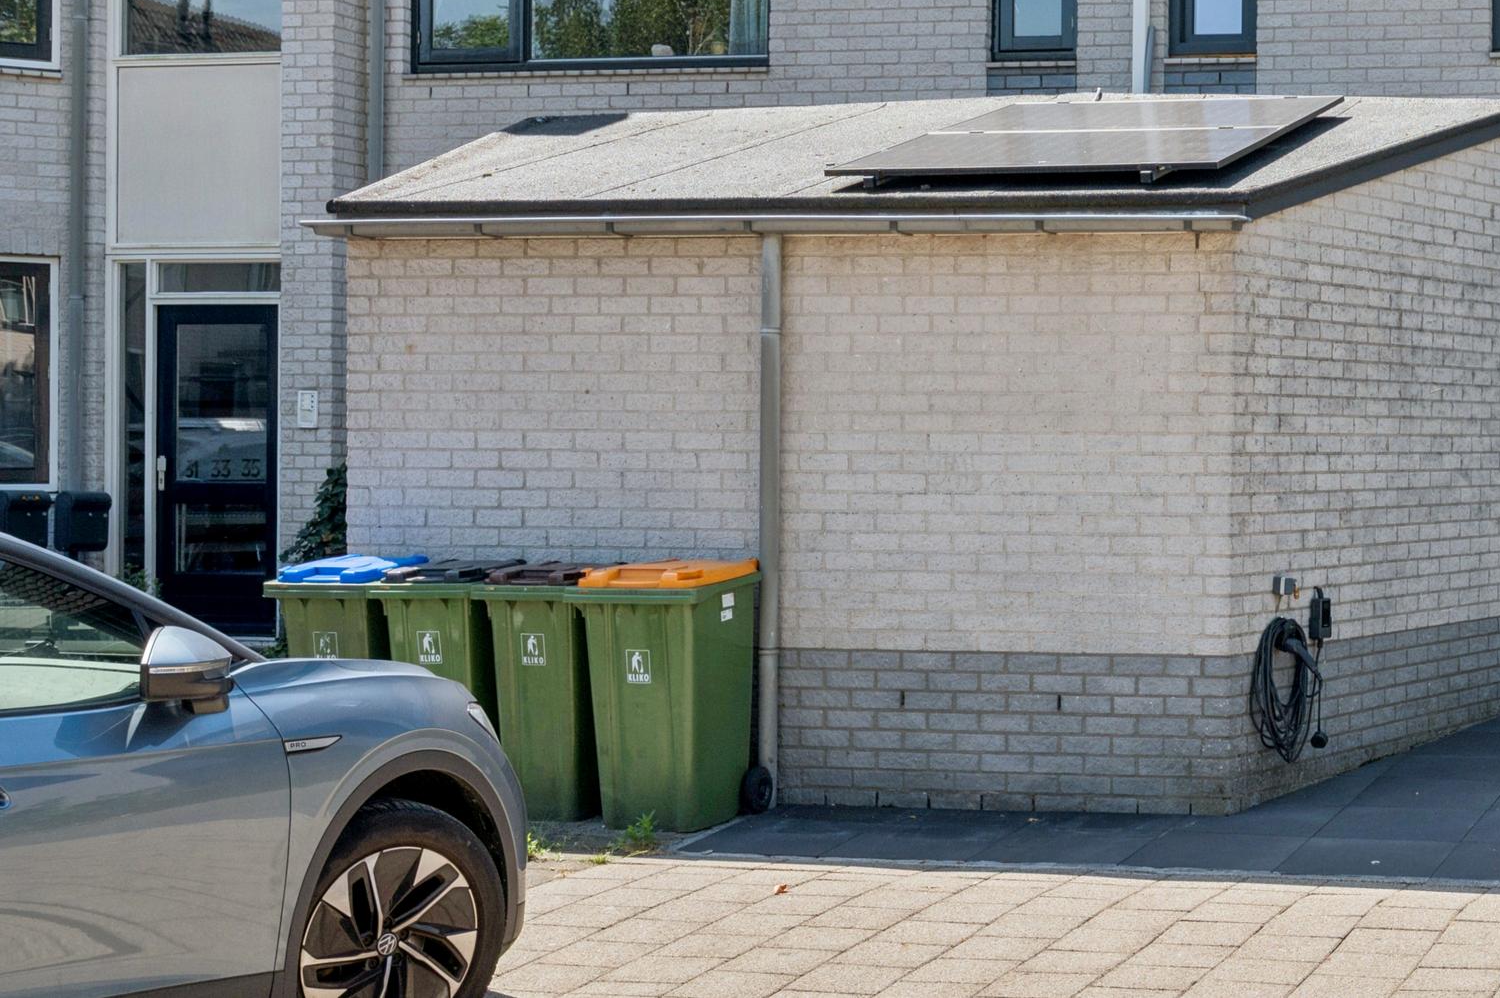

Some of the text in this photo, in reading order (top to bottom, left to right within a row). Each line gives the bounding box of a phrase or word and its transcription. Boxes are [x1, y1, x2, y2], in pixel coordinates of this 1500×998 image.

[185, 458, 261, 478] 31 33 35
[420, 654, 440, 662] KLIKO
[523, 656, 544, 664] KLIKO
[628, 673, 650, 682] KLIKO
